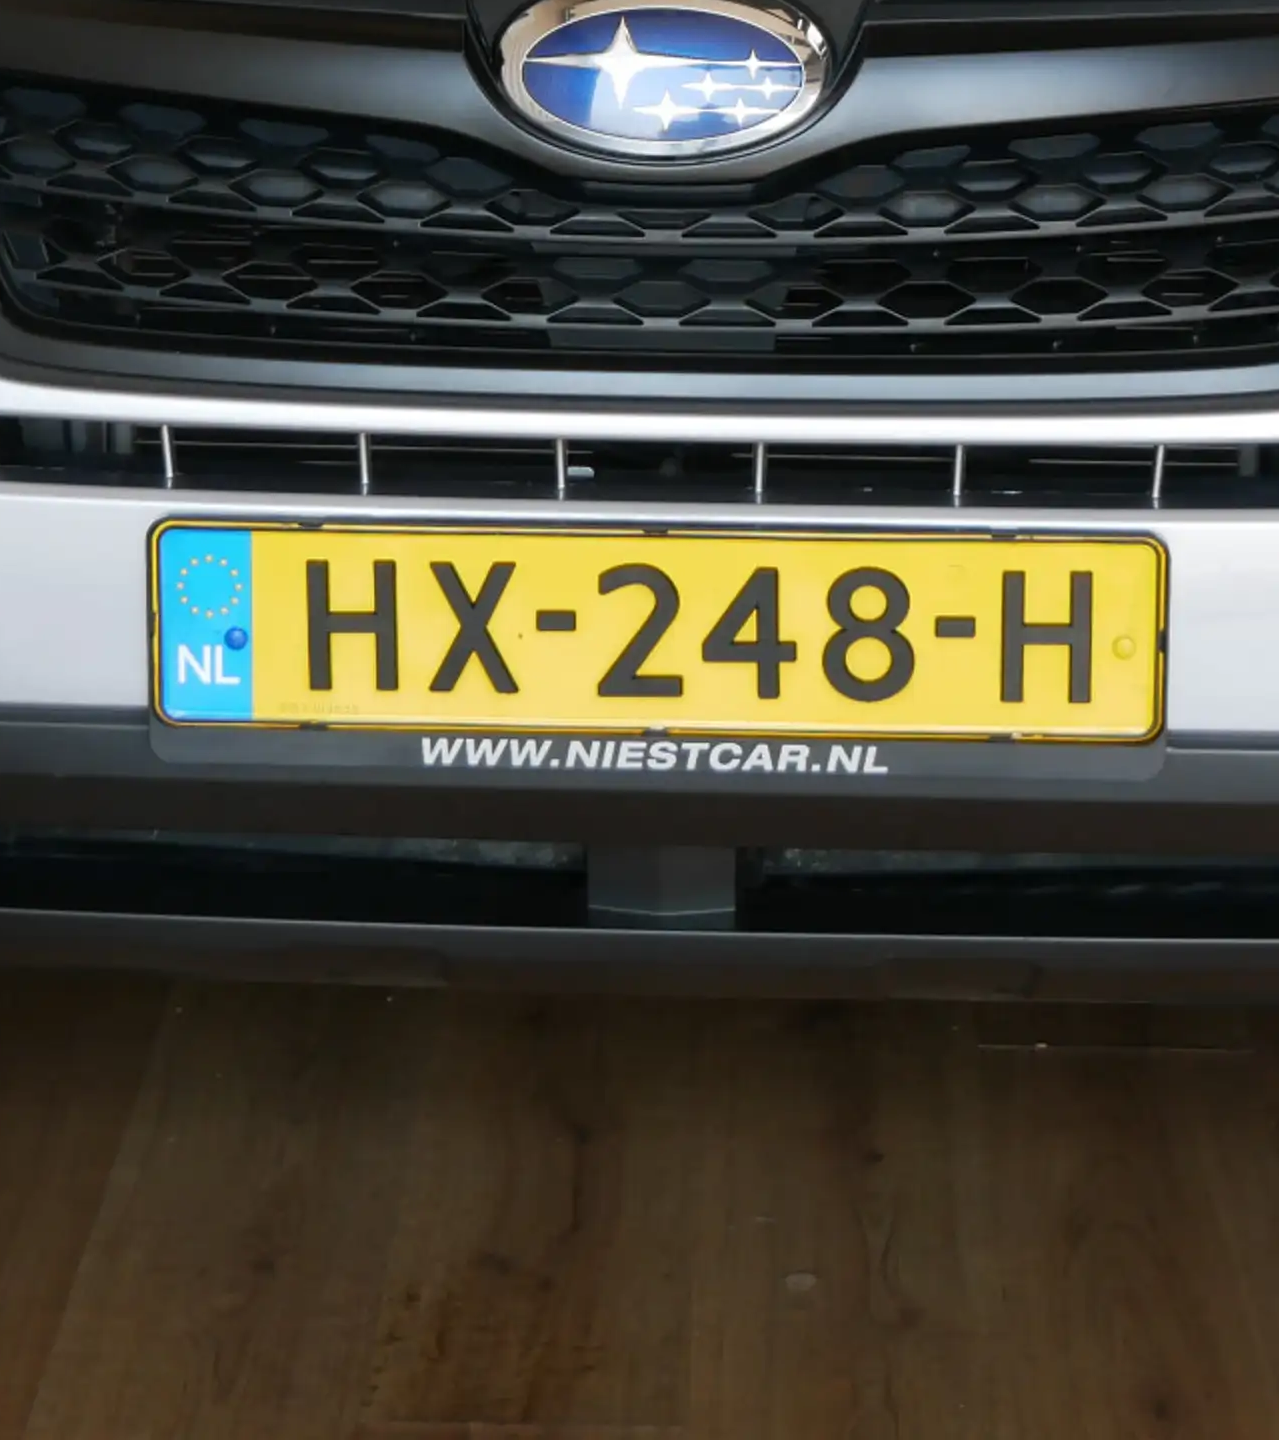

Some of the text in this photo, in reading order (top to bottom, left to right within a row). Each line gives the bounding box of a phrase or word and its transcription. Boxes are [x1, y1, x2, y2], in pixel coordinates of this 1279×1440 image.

[305, 558, 1093, 704] HX-248-H
[177, 643, 241, 685] NL
[420, 736, 890, 775] WWW.NIESTCAR.NL
